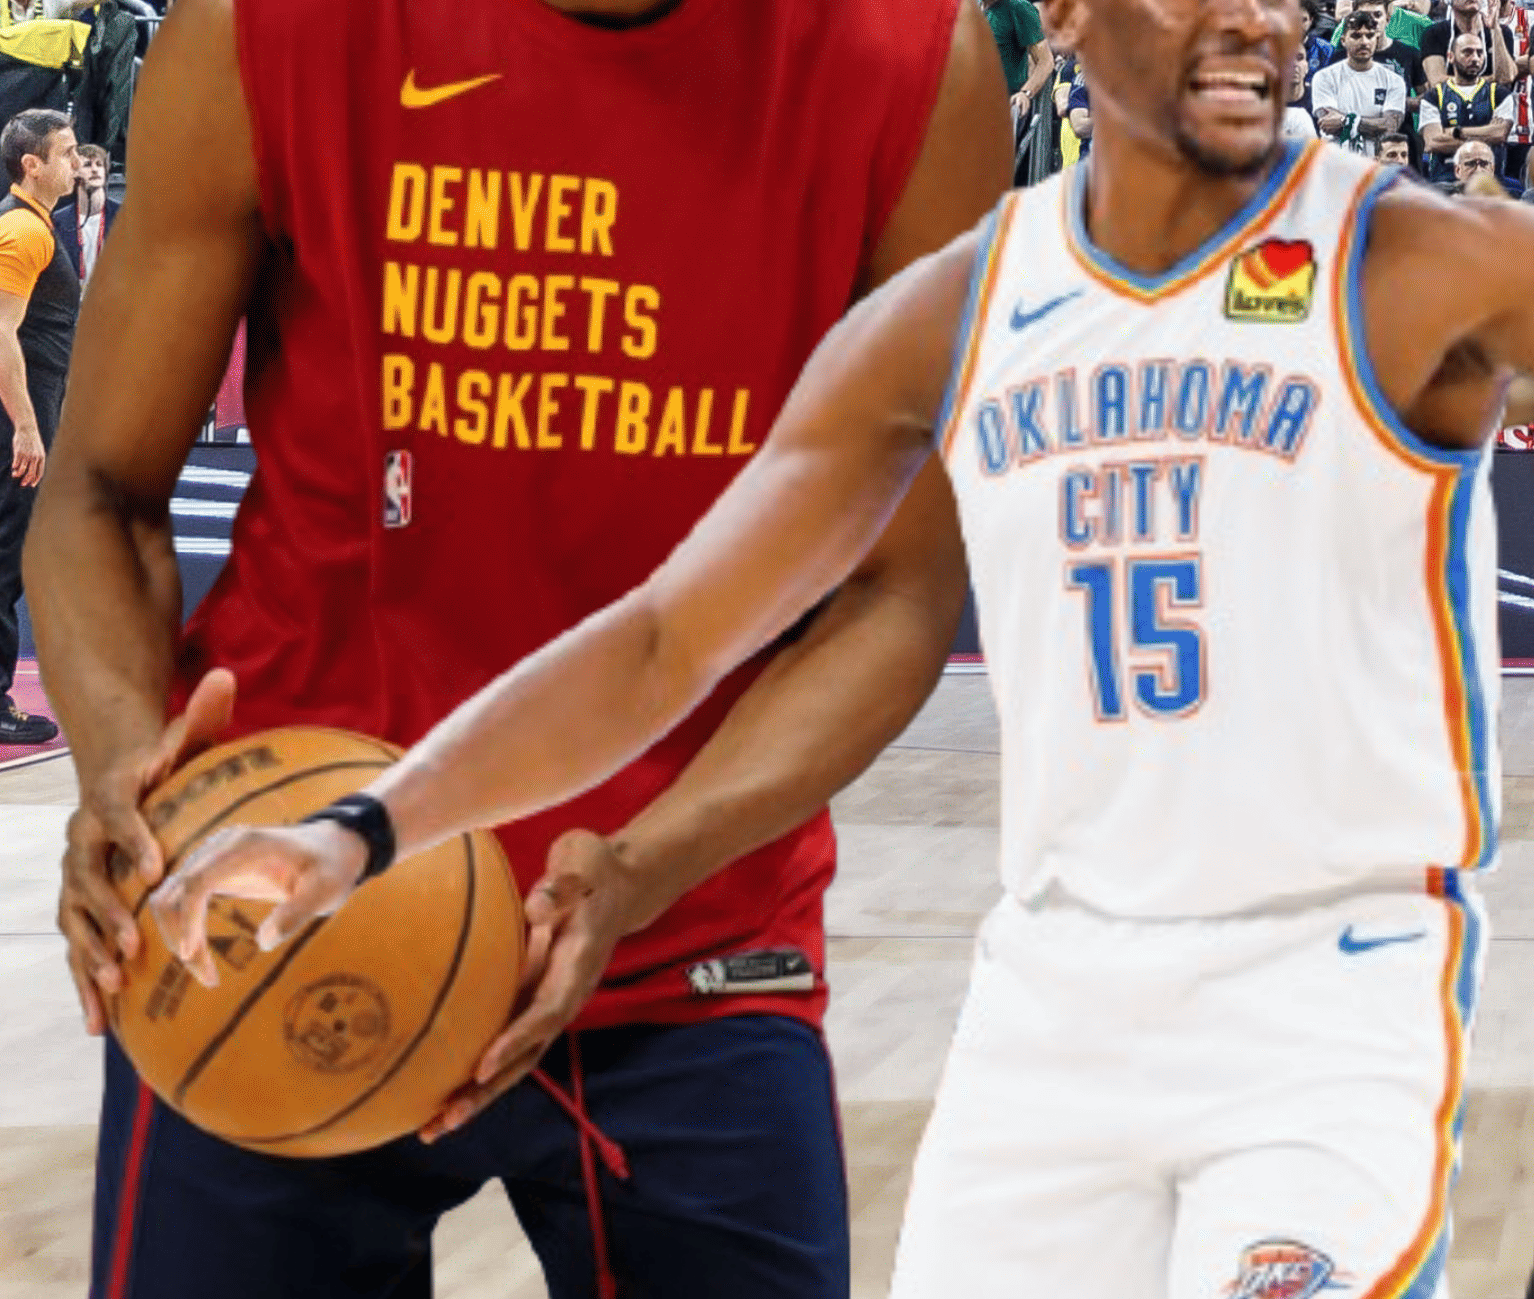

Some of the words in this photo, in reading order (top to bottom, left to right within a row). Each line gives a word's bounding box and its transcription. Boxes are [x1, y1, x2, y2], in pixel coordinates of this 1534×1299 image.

[386, 162, 618, 256] DENVER
[381, 260, 660, 360] NUGGETS
[382, 353, 756, 457] BASKETBALL
[974, 357, 1322, 477] OKLAHOMA
[1059, 454, 1206, 549] CITY
[1065, 552, 1210, 724] 15
